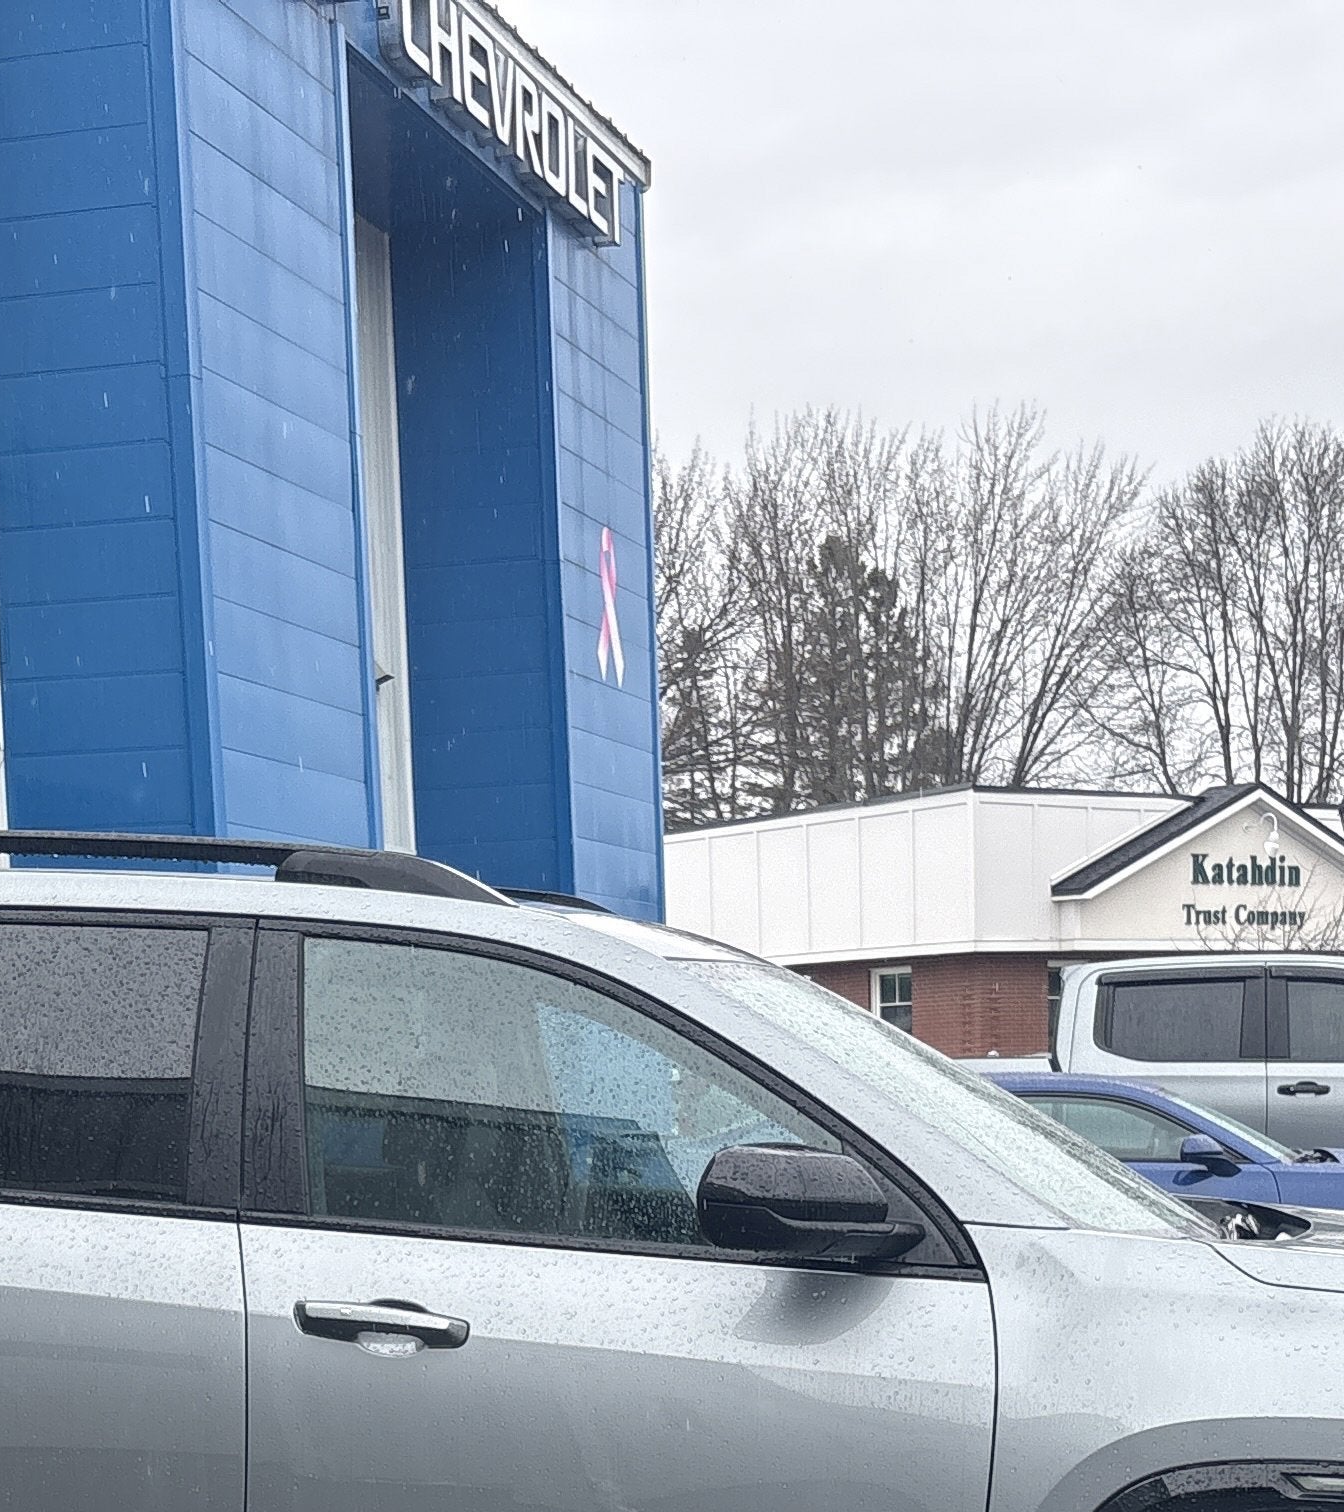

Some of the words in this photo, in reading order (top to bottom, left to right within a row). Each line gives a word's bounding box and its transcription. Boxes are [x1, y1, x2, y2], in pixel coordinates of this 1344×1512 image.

[1190, 853, 1301, 887] Katahdin
[1182, 904, 1227, 926] Trust
[1234, 904, 1306, 931] Company
